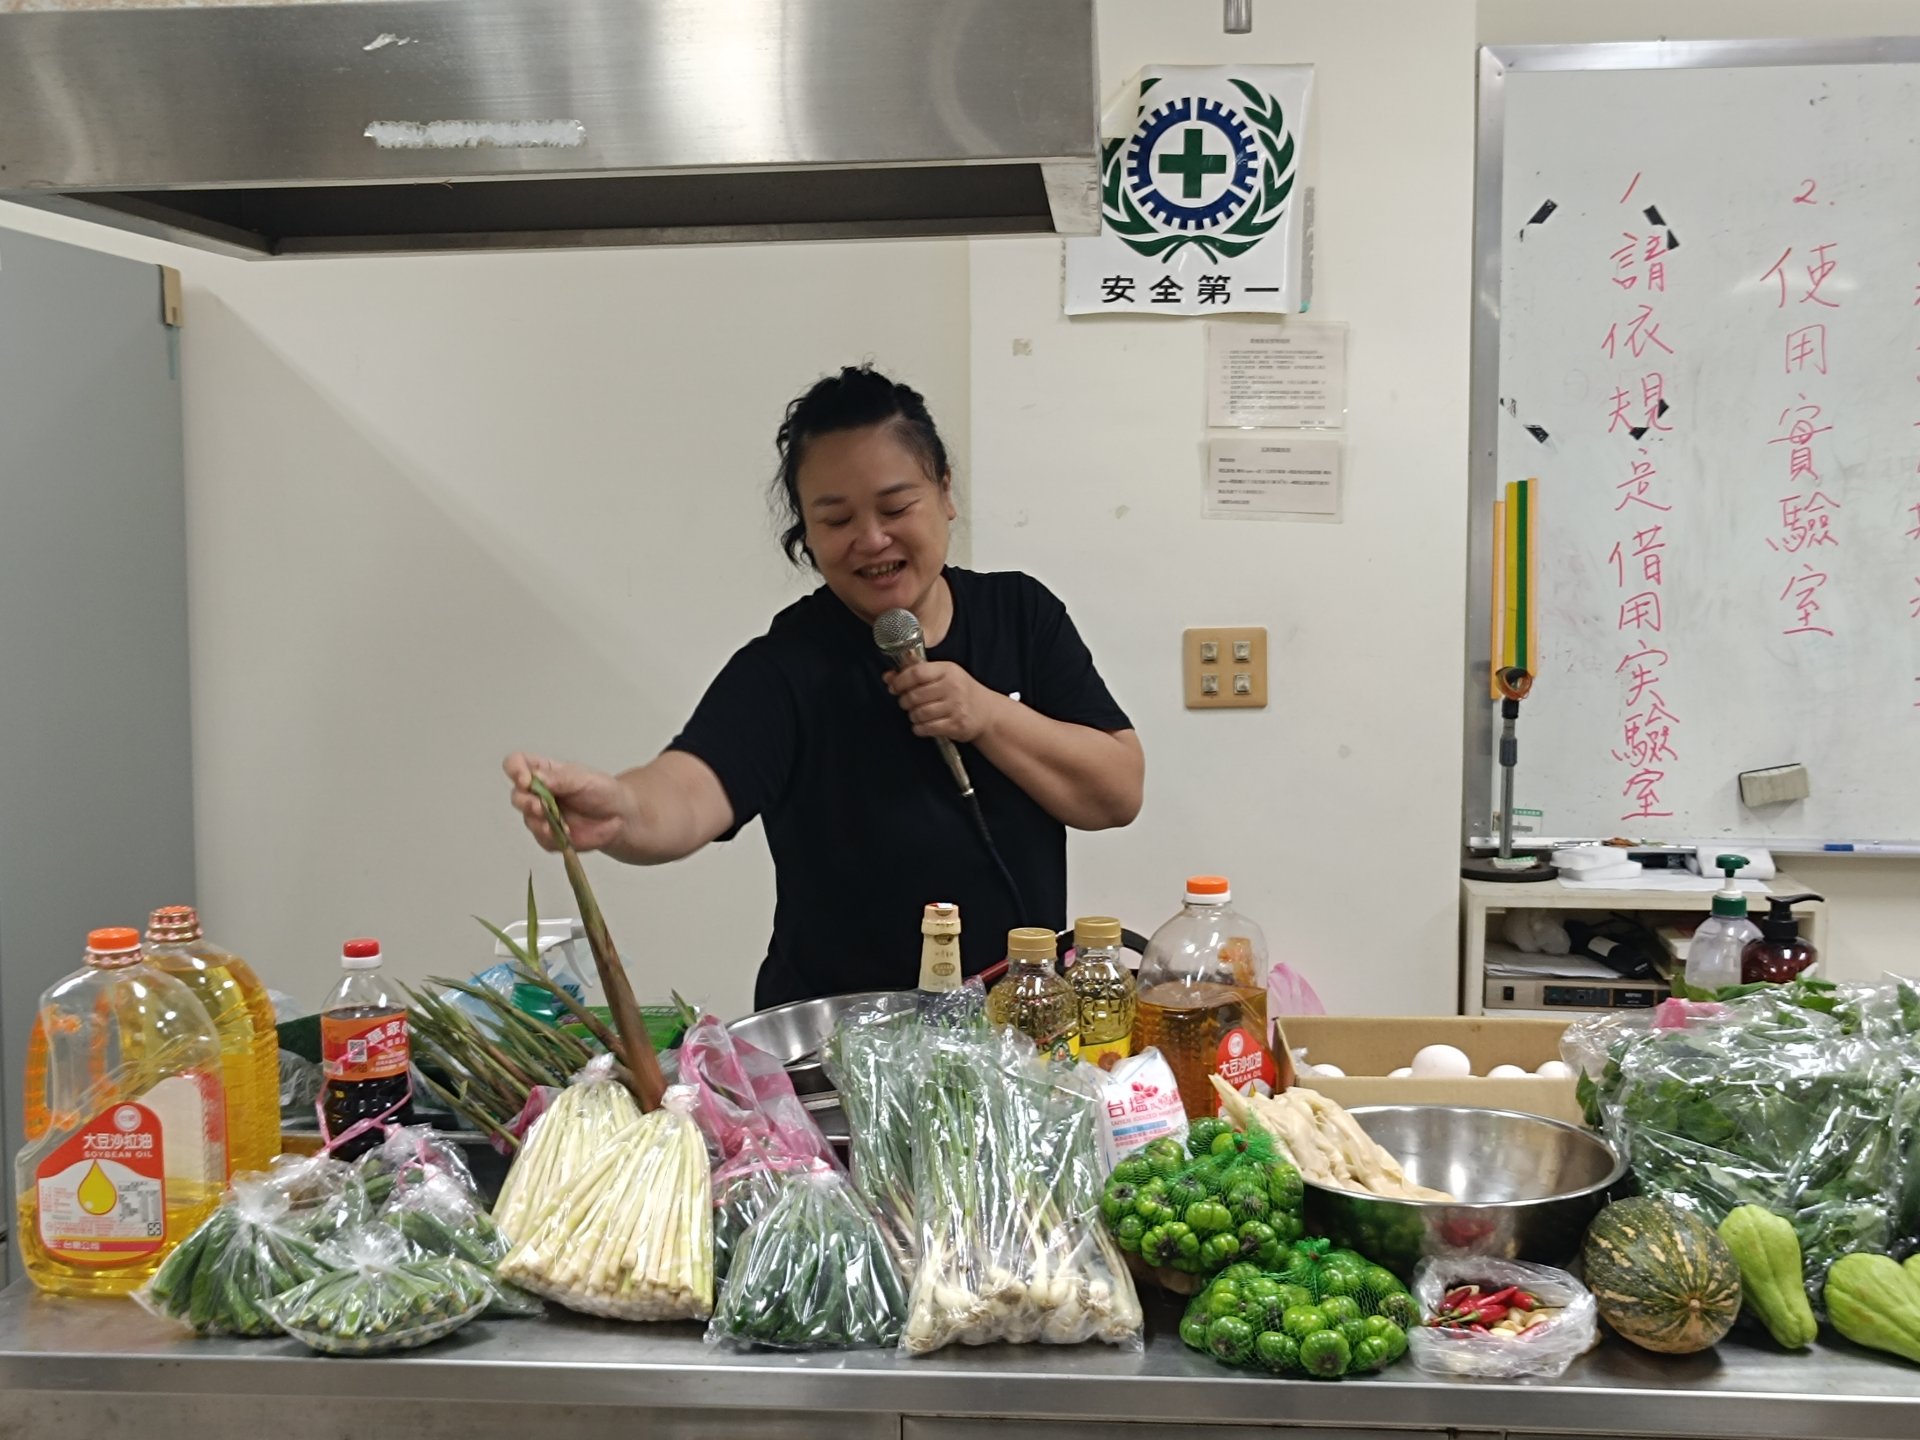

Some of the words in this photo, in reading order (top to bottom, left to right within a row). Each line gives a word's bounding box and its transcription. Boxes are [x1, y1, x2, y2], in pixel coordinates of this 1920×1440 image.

[1101, 275, 1279, 304] 安全第一
[83, 1133, 153, 1149] 大豆沙拉油
[135, 1150, 153, 1158] OIL
